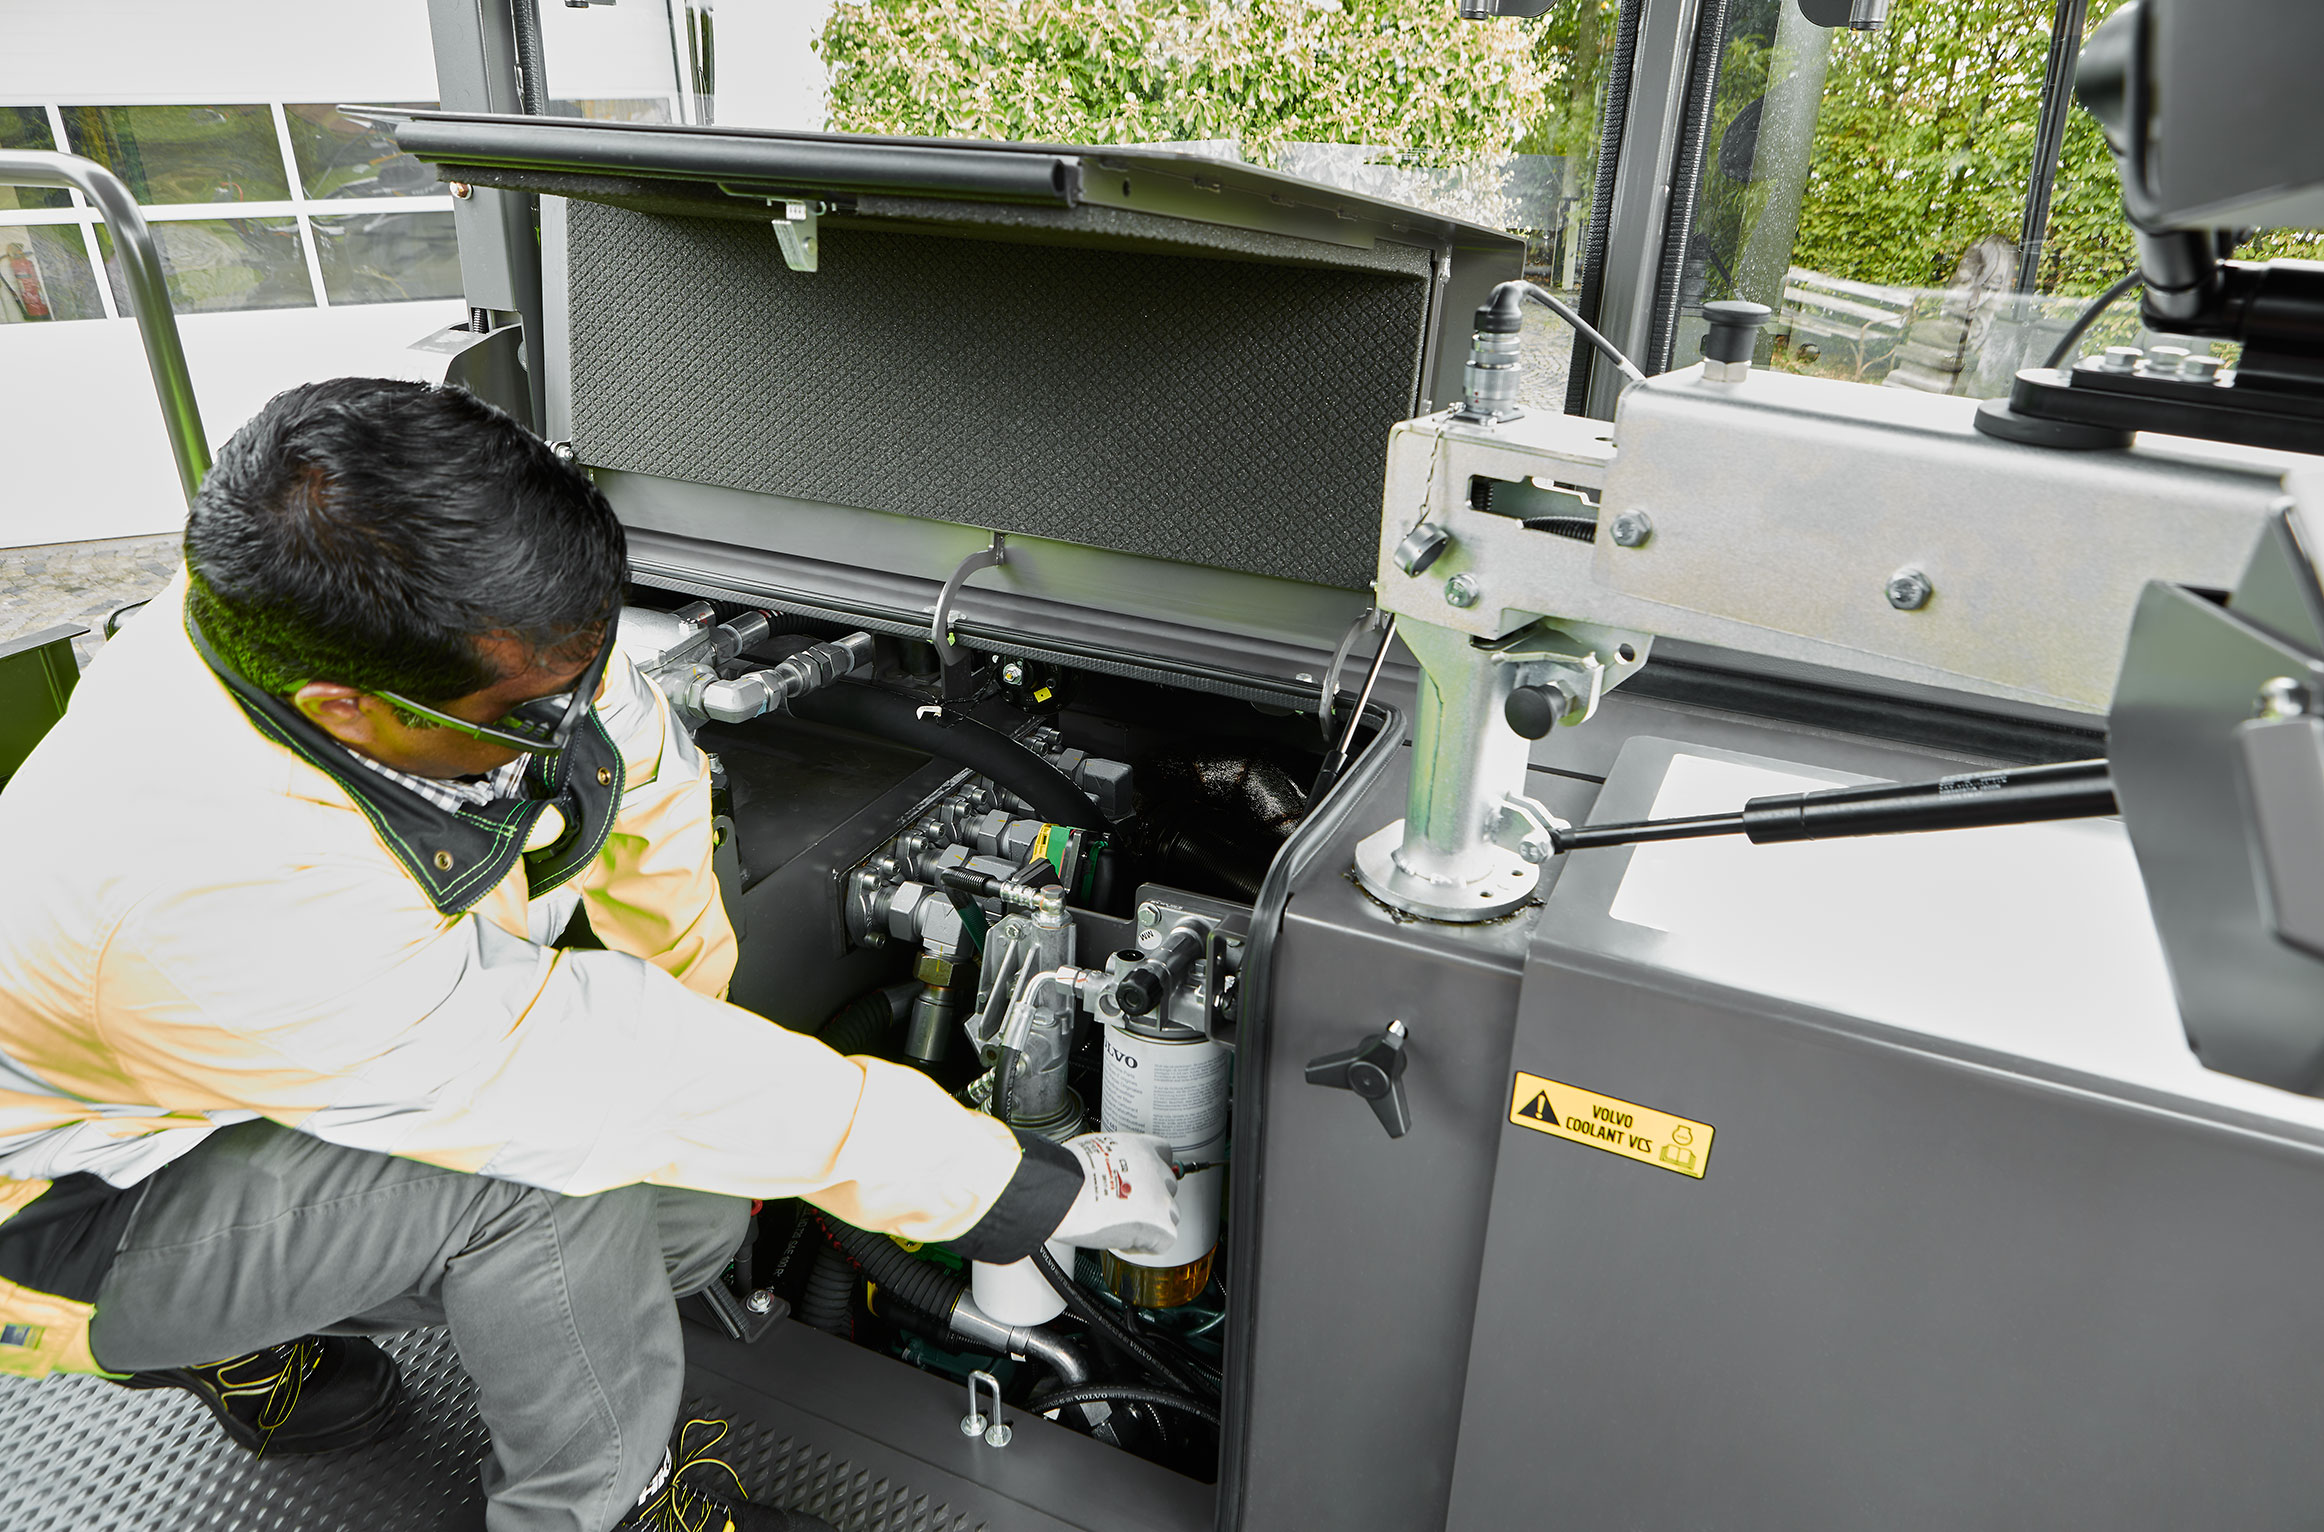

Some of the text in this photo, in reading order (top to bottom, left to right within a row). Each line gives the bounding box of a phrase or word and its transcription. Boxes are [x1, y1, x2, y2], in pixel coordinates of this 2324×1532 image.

[1104, 1039, 1138, 1069] LVO
[1592, 1105, 1633, 1129] VOLVO
[1566, 1117, 1653, 1153] COOLANT VCS
[1039, 1245, 1056, 1272] VOLVO
[1130, 1340, 1153, 1361] VOLVO
[1075, 1392, 1108, 1401] VOLVO
